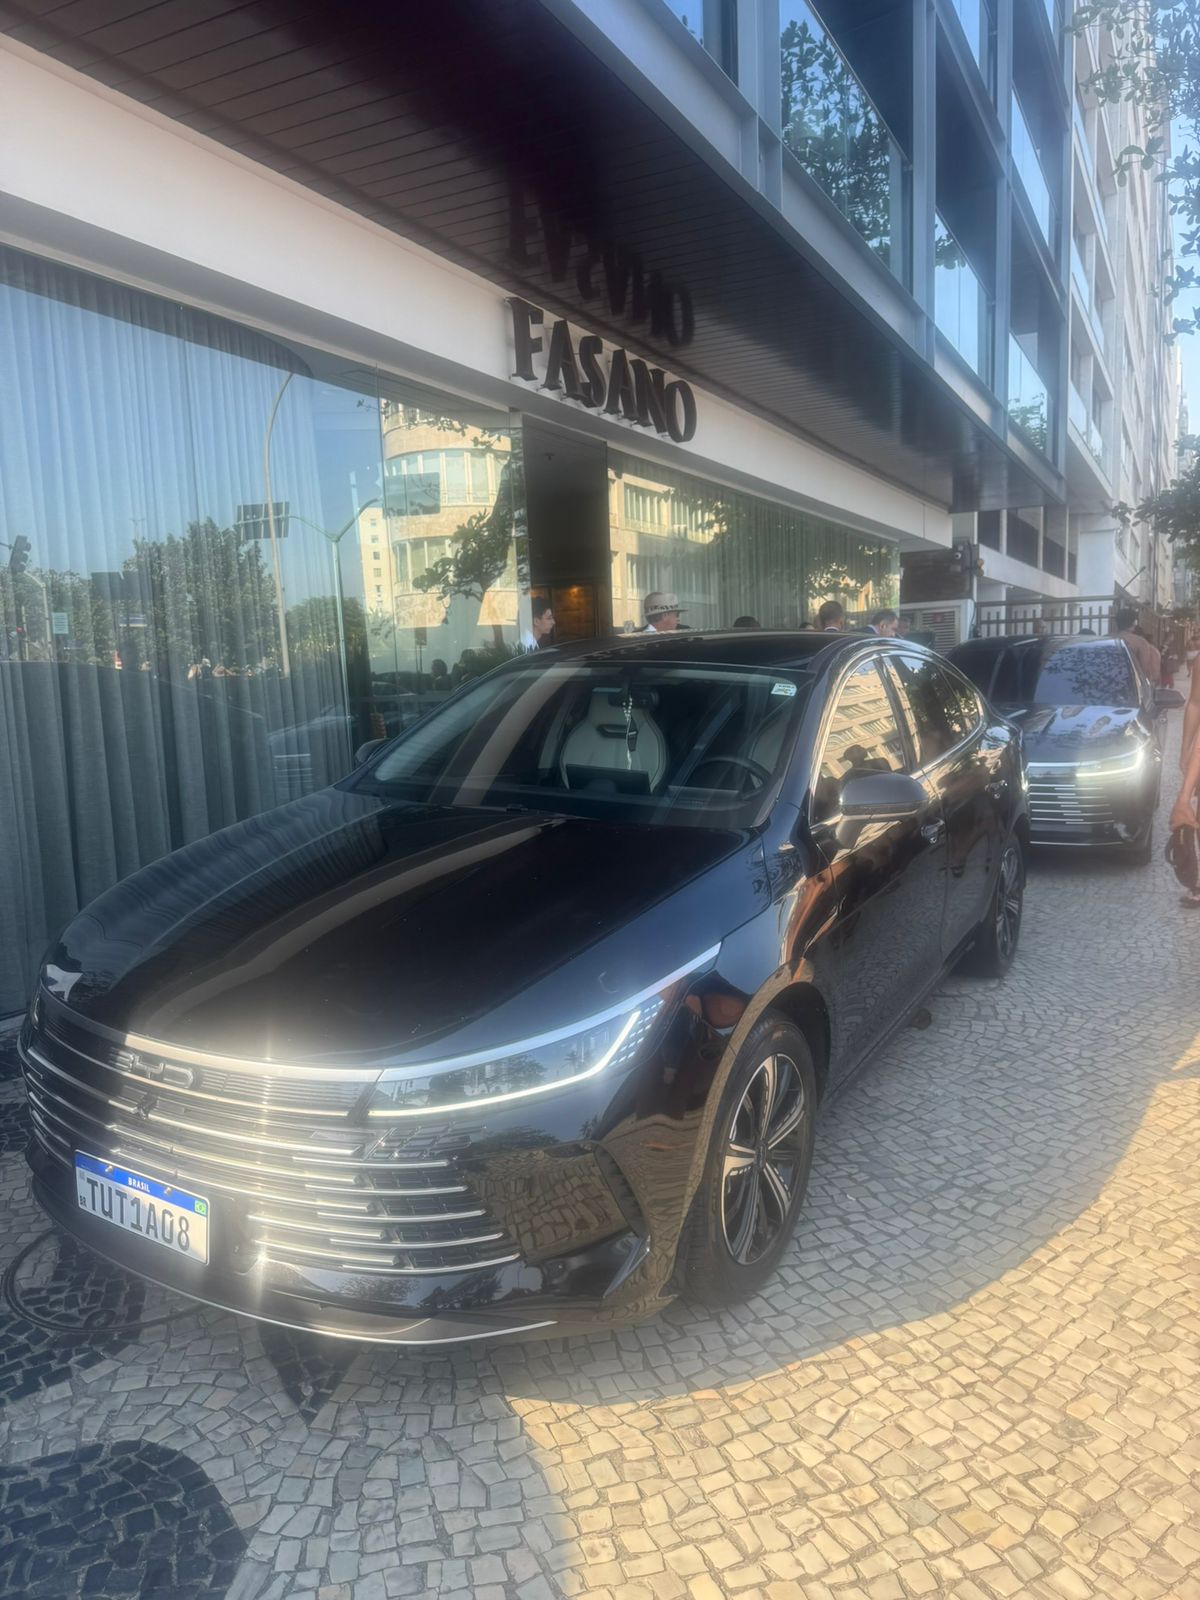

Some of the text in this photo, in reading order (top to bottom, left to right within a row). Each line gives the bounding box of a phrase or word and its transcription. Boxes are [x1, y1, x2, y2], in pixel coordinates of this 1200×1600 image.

[504, 296, 697, 443] FASANO
[112, 1049, 194, 1089] BYD
[127, 1176, 150, 1193] BRASIL
[86, 1177, 190, 1251] TUT1A08
